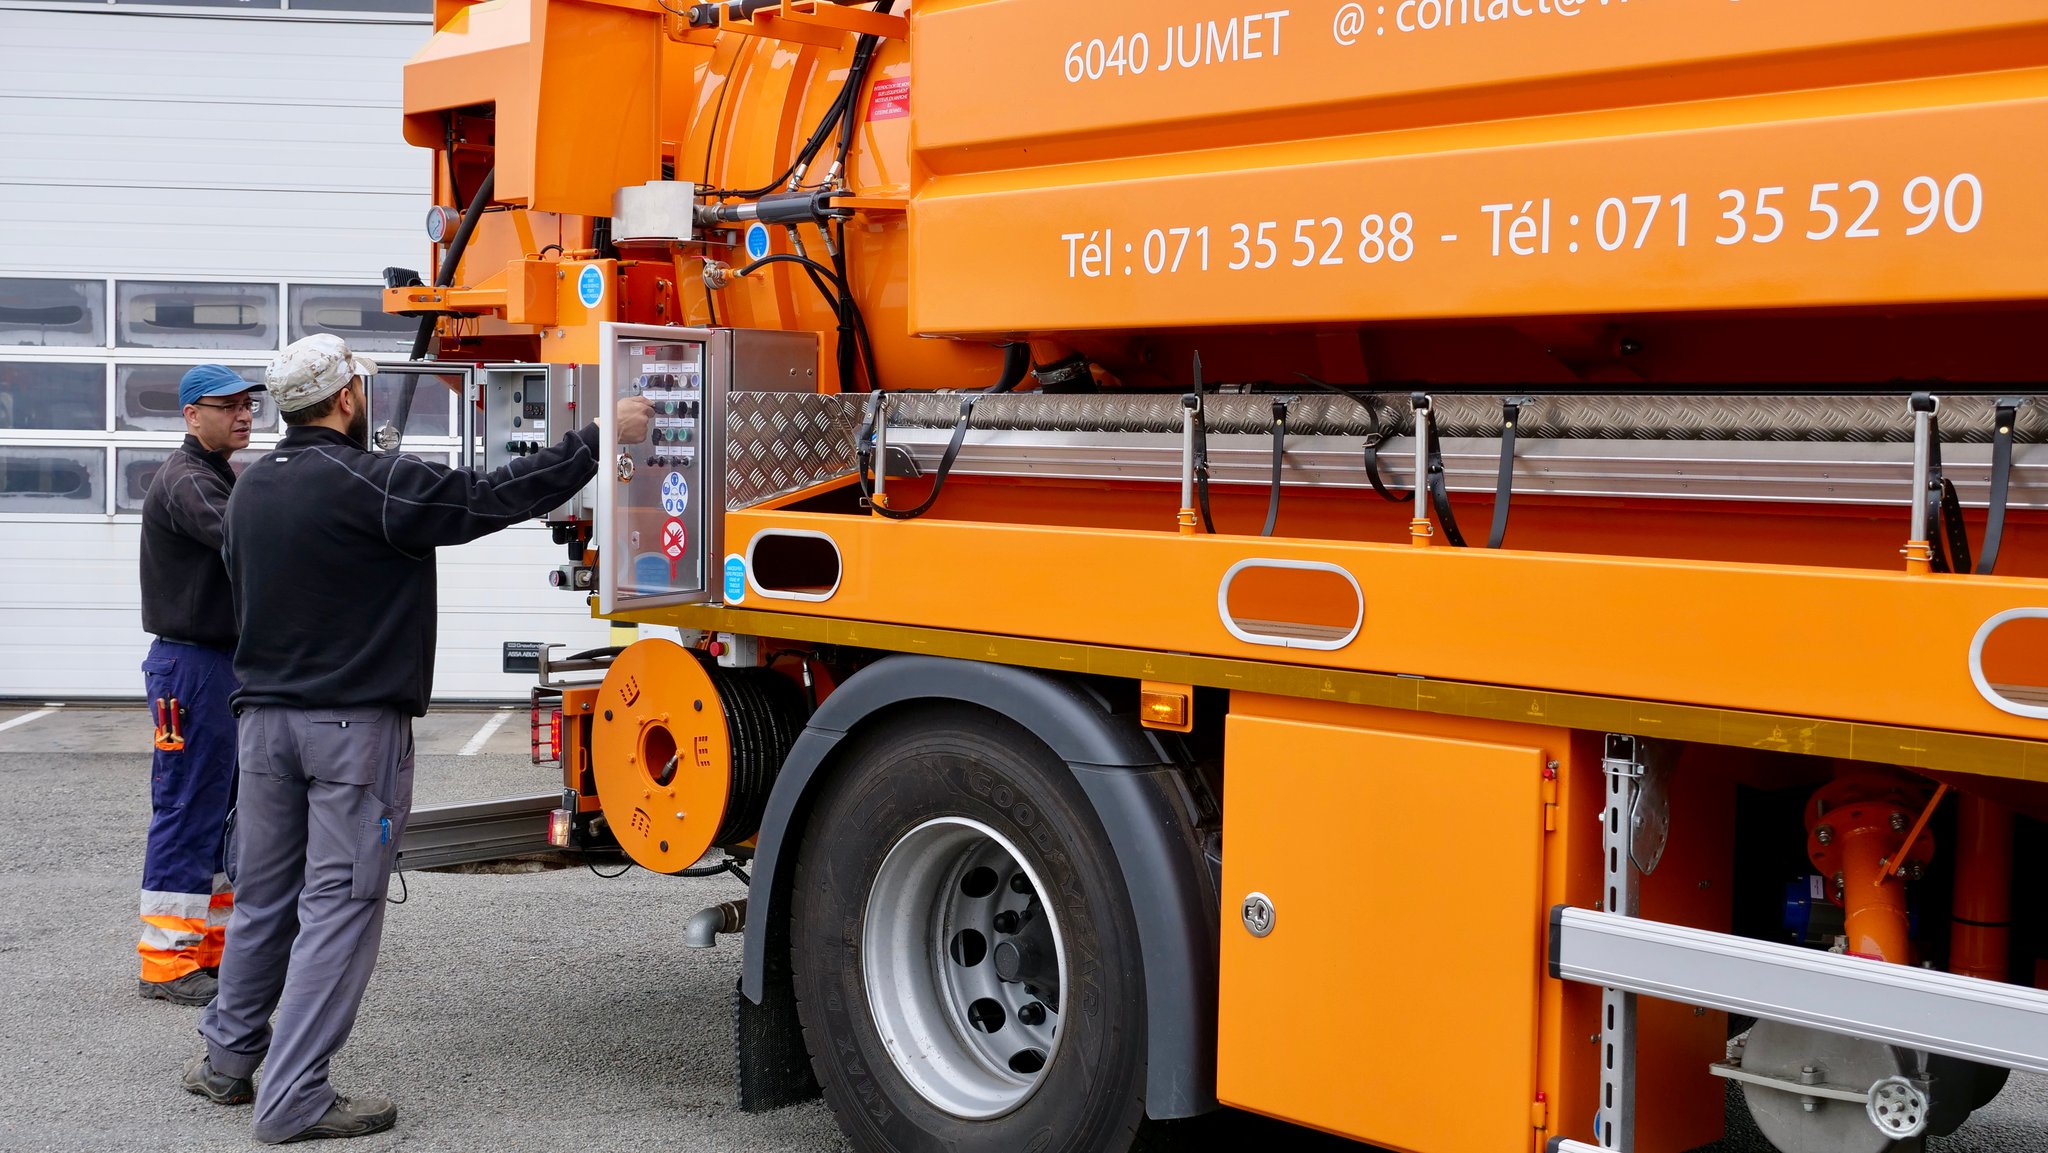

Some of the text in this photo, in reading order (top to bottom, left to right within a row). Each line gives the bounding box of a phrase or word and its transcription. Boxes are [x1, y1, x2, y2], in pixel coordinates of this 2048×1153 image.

[1065, 10, 1289, 84] 6040 JUMET
[1334, 3, 1364, 46] @
[1062, 229, 1111, 277] Tél
[1144, 226, 1208, 274] 071
[1229, 222, 1276, 269] 35
[1292, 217, 1343, 266] 52
[1359, 212, 1413, 263] 88
[1481, 199, 1550, 256] Tél
[1596, 193, 1687, 250] 071
[1716, 187, 1784, 245] 35
[1807, 180, 1879, 240] 52
[1903, 173, 1982, 235] 90
[836, 1036, 894, 1127] KMAX
